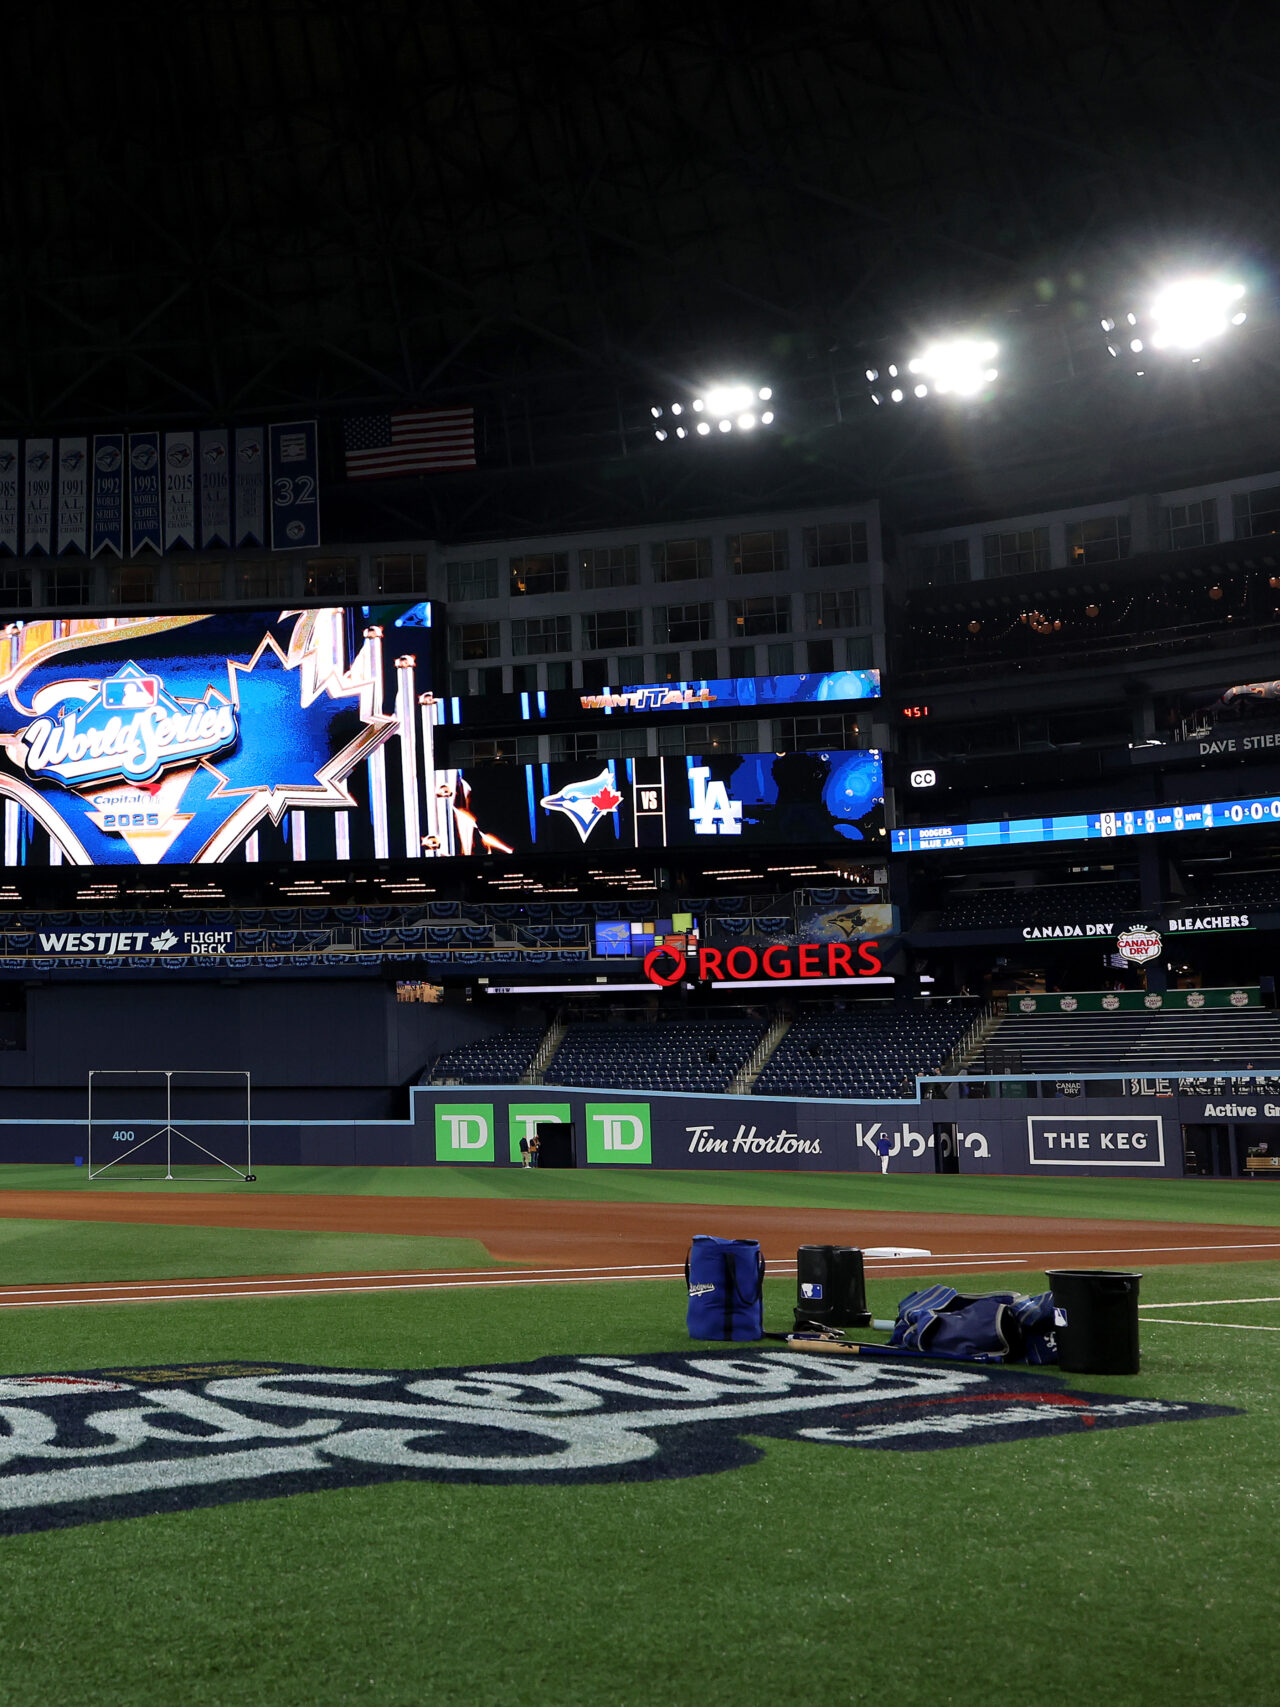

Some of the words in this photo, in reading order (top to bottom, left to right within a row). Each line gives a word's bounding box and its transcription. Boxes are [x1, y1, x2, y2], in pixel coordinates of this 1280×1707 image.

[27, 480, 50, 496] 1989
[62, 480, 84, 496] 1991
[96, 478, 120, 494] 1992
[133, 474, 157, 492] 1993
[168, 474, 192, 490] 2015
[274, 476, 316, 506] 32
[96, 497, 120, 506] WORLD
[134, 494, 158, 505] WORLD
[27, 513, 48, 525] EAST
[61, 512, 84, 524] EAST
[1200, 740, 1236, 755] DAVE
[640, 790, 658, 810] VS
[104, 814, 158, 827] 2025
[1231, 805, 1244, 822] 0
[1250, 803, 1264, 820] 0
[920, 828, 952, 838] DODGERS
[1104, 814, 1112, 824] 0
[1124, 812, 1132, 824] 0
[1146, 810, 1154, 822] 0
[1174, 807, 1182, 818] 0
[1203, 804, 1212, 815] 4
[920, 839, 942, 848] BLUE
[944, 838, 964, 847] JAYS
[1105, 826, 1112, 836] 0
[1124, 824, 1134, 835] 0
[1146, 822, 1156, 833] 0
[1175, 819, 1184, 830] 0
[1204, 816, 1214, 828] 4
[898, 836, 904, 845] 1
[1022, 924, 1082, 939] CANADA
[1086, 924, 1114, 936] DRY
[1169, 915, 1250, 932] BLEACHERS
[39, 932, 150, 956] WESTJET
[184, 932, 233, 944] FLIGHT
[1117, 938, 1160, 948] CANADA
[190, 944, 227, 954] DECK
[1129, 948, 1150, 956] DRY
[699, 942, 882, 980] ROGERS
[1204, 1104, 1257, 1116] Active
[112, 1130, 134, 1141] 400
[442, 1114, 488, 1150] TD
[592, 1114, 644, 1150] TD
[686, 1125, 723, 1154] Tim
[732, 1124, 820, 1154] Hortons
[1044, 1132, 1090, 1150] THE
[1100, 1132, 1146, 1150] KEG
[204, 1350, 988, 1470] Series
